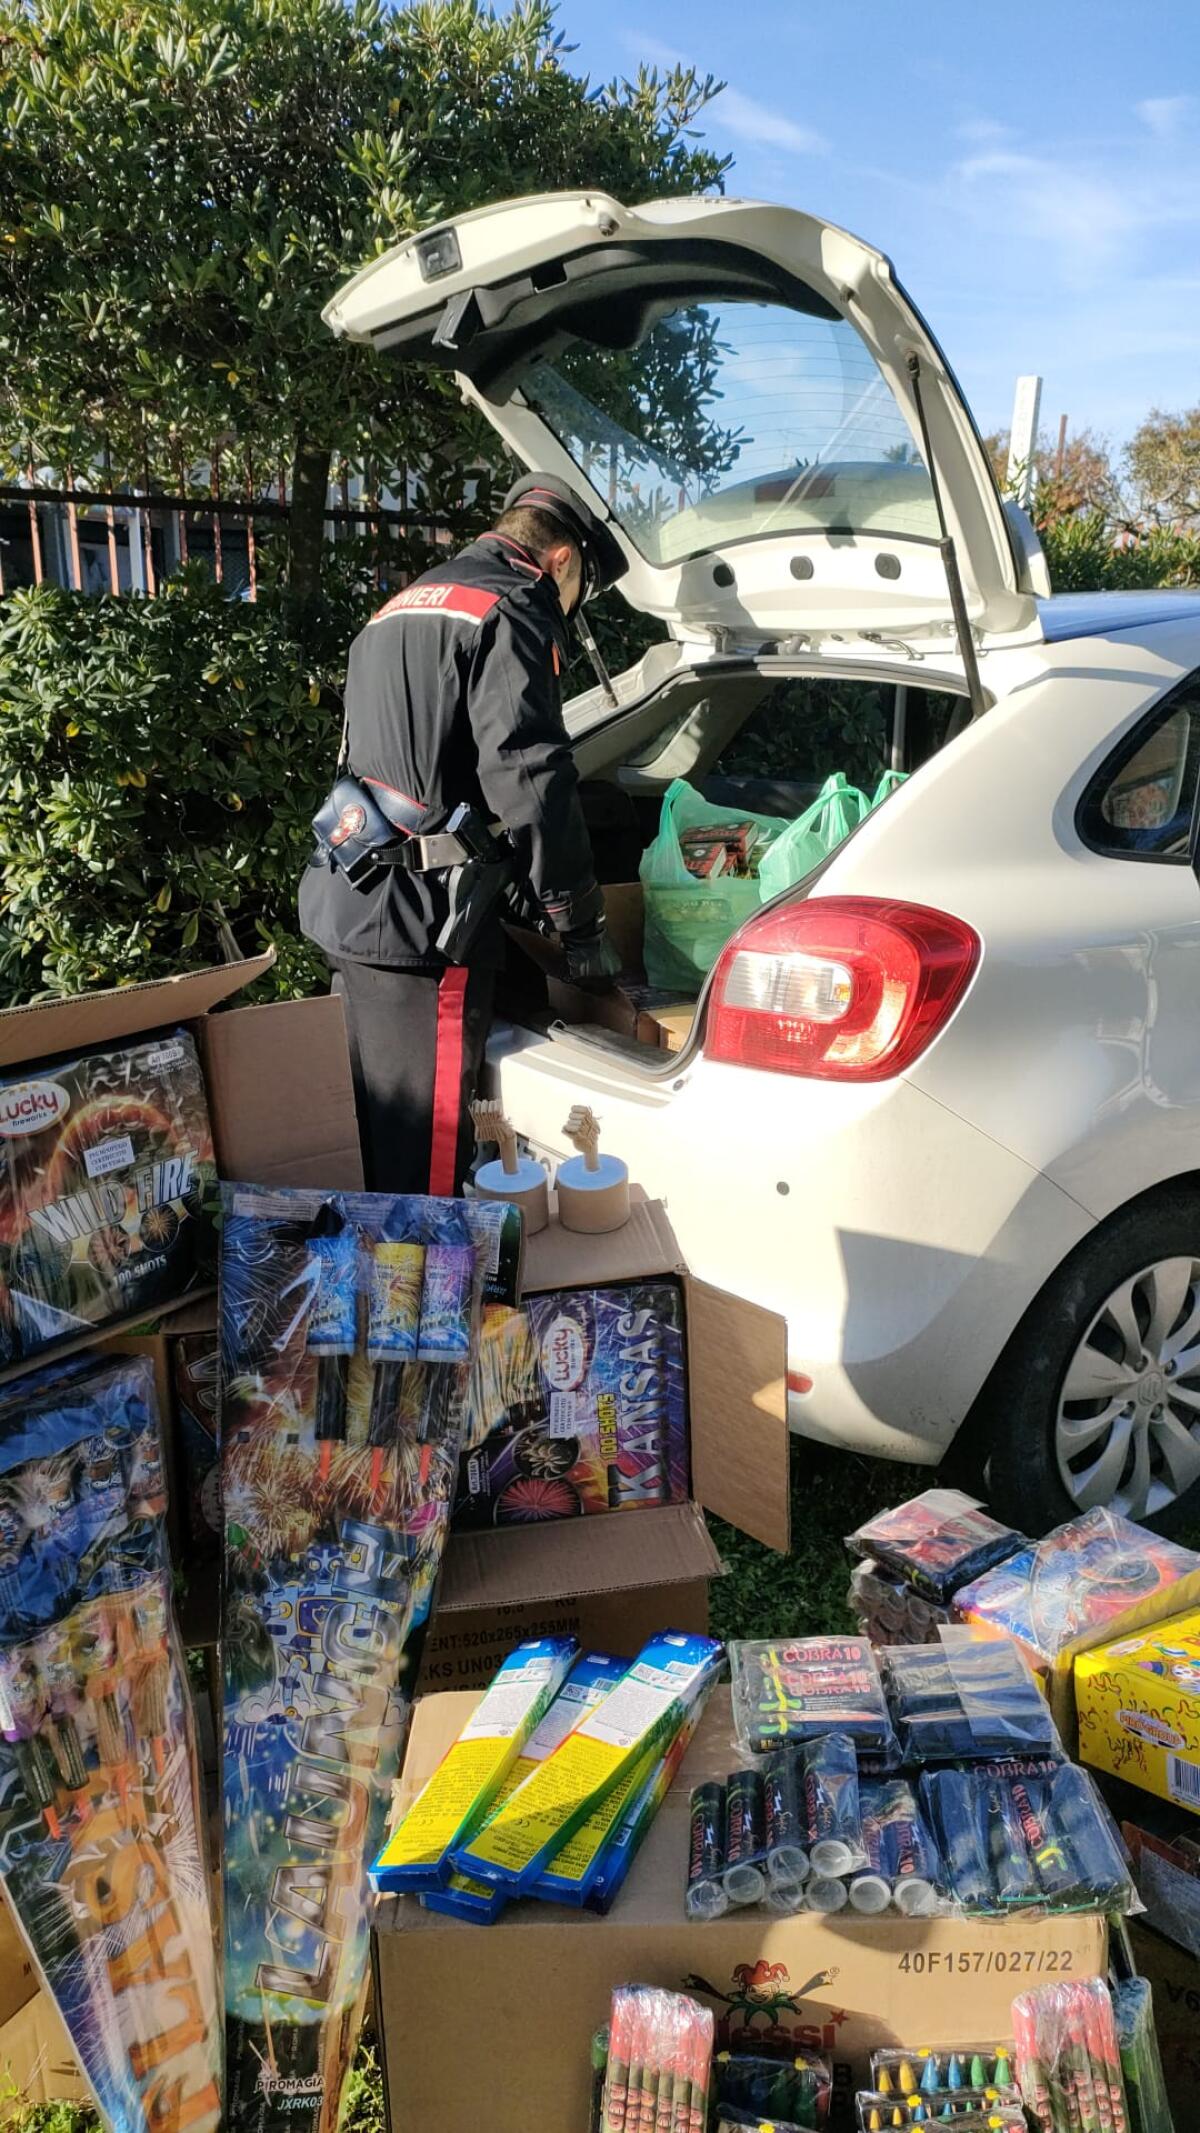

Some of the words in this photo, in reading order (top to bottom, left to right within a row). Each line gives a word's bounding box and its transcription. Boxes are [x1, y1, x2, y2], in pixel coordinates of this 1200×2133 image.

[27, 1180, 126, 1244] WILD
[135, 1149, 200, 1215] FIRE
[134, 1254, 167, 1281] SHOTS
[552, 1327, 574, 1382] Lucky
[597, 1393, 618, 1435] SHOTS
[608, 1308, 663, 1507] KANSAS
[600, 1438, 618, 1461] 100
[425, 1657, 453, 1680] KS
[457, 1650, 512, 1677] UN03
[783, 1646, 843, 1663] COBRA
[844, 1646, 861, 1661] 10
[254, 1518, 418, 2003] LAUNCH
[973, 1762, 1038, 1778] COBRA
[728, 1799, 744, 1846] COBRA
[898, 1950, 1074, 1976] 40F157/027/22
[256, 2076, 325, 2092] PIROMAGIA
